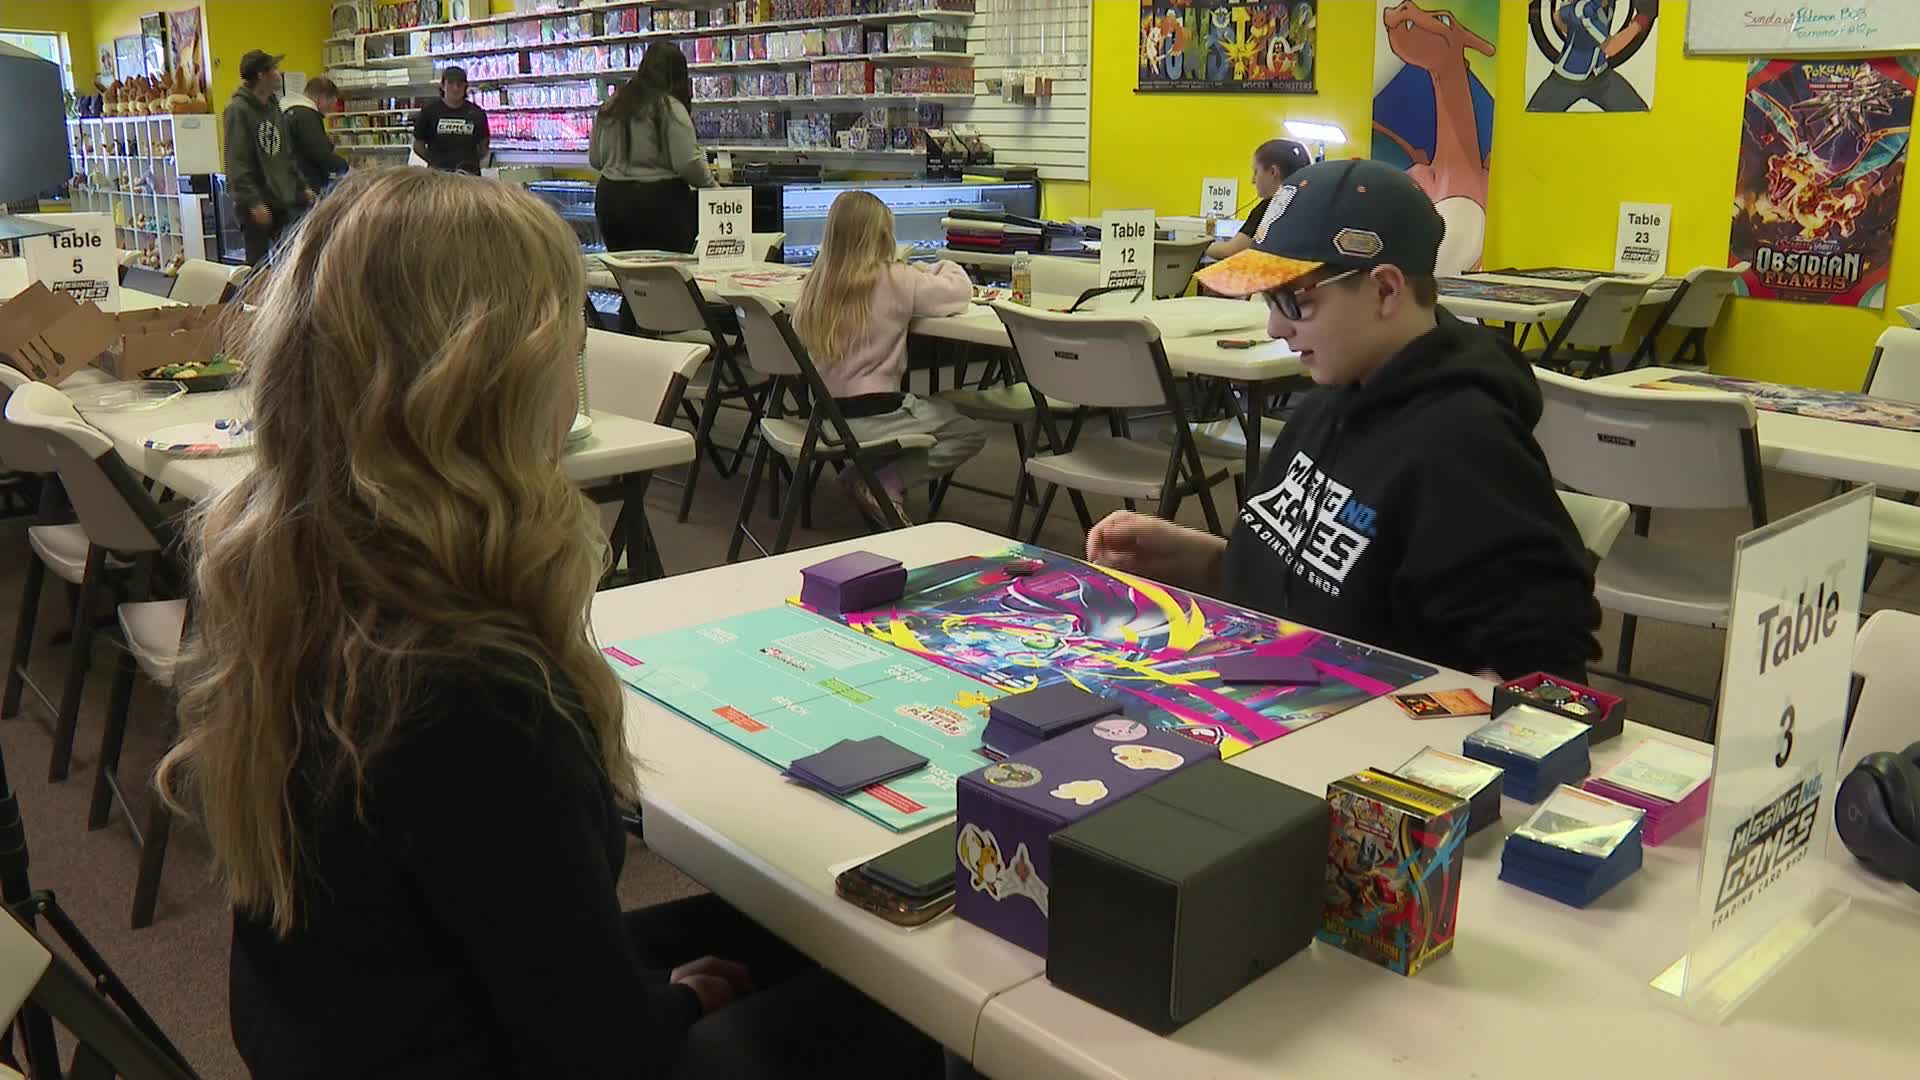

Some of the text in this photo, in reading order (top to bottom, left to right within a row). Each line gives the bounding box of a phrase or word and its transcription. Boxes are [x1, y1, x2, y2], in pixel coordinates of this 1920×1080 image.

[1209, 186, 1231, 196] Table
[708, 202, 743, 215] Table
[1213, 201, 1224, 211] 25
[1628, 213, 1661, 226] Table
[719, 222, 733, 235] 13
[1111, 222, 1146, 238] Table
[48, 231, 102, 249] Table
[1635, 232, 1650, 243] 23
[707, 246, 744, 255] GAMES
[1120, 248, 1135, 263] 12
[73, 259, 84, 274] 5
[1756, 247, 1860, 283] OBSIDIAN
[1108, 277, 1145, 288] GAMES
[1765, 269, 1845, 289] FLAMES
[1240, 508, 1287, 557] TRADING
[1308, 570, 1341, 597] SHOP
[1758, 582, 1840, 675] Table
[1775, 705, 1796, 768] 3
[1731, 787, 1801, 857] MISSING
[1718, 801, 1817, 906] GAMES
[1711, 890, 1754, 931] TRADING
[1758, 868, 1782, 894] CARD
